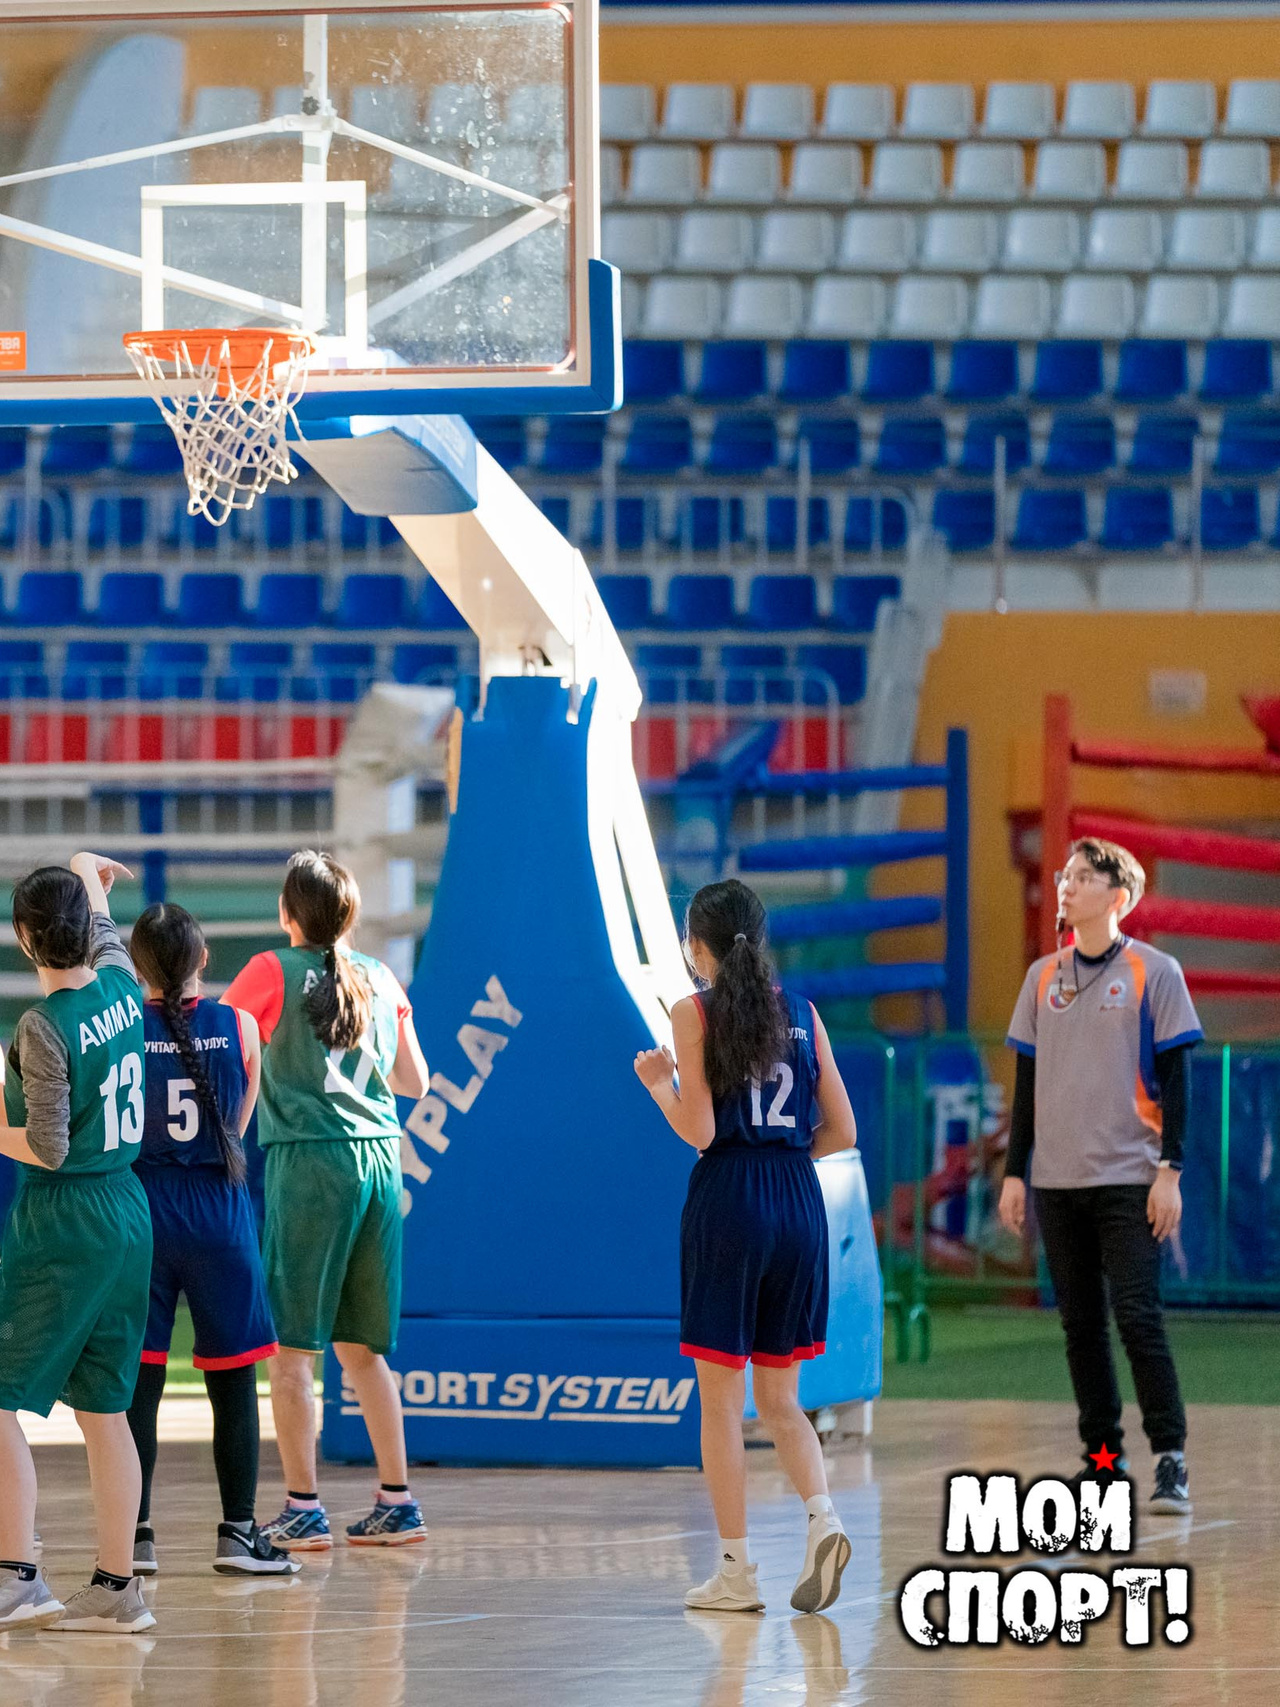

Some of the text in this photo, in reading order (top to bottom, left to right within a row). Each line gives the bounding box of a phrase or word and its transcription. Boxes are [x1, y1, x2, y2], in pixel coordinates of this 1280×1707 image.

[202, 1036, 229, 1051] УЛУС
[99, 1052, 145, 1153] 13
[167, 1078, 199, 1142] 5
[400, 974, 523, 1219] YPLAY
[744, 1061, 796, 1128] 12
[341, 1370, 695, 1419] SORT SYSTEM
